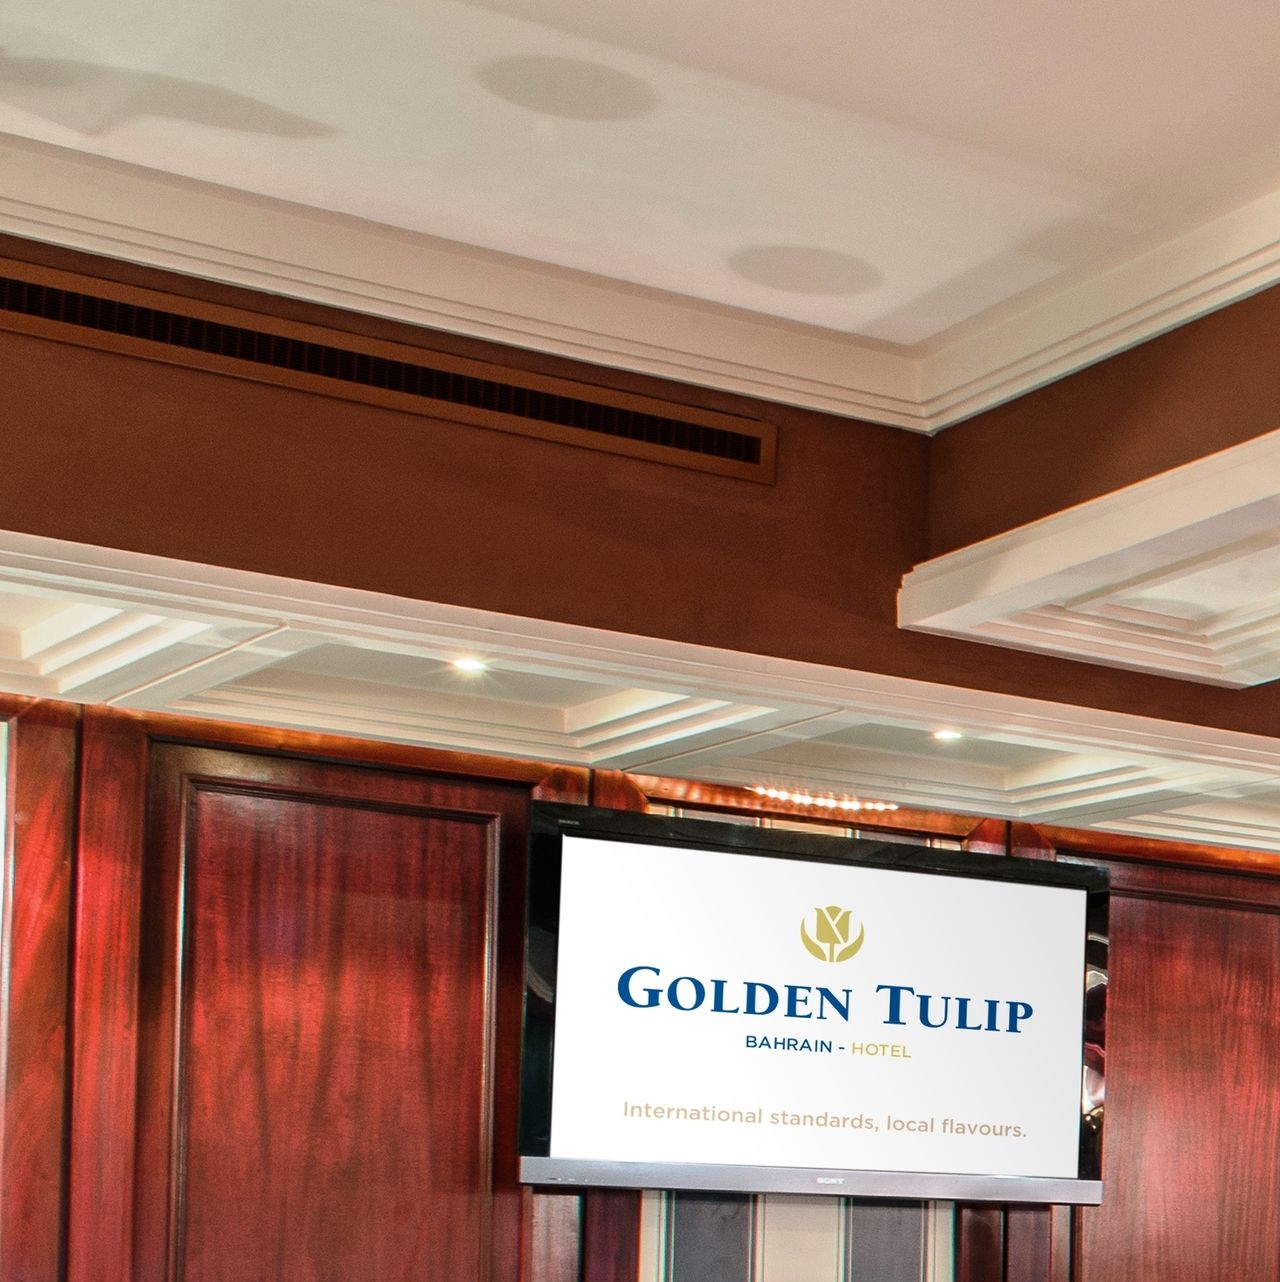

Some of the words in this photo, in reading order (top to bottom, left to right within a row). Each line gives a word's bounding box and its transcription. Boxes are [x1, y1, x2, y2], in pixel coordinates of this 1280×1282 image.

[617, 965, 853, 1022] GOLDEN
[875, 984, 1034, 1034] TULIP
[745, 1034, 833, 1054] BAHRAIN
[851, 1041, 912, 1058] HOTEL
[623, 1100, 763, 1125] International
[769, 1109, 880, 1133] standards,
[886, 1114, 935, 1133] local
[941, 1117, 1027, 1138] flavours.
[816, 1176, 845, 1186] SONY
